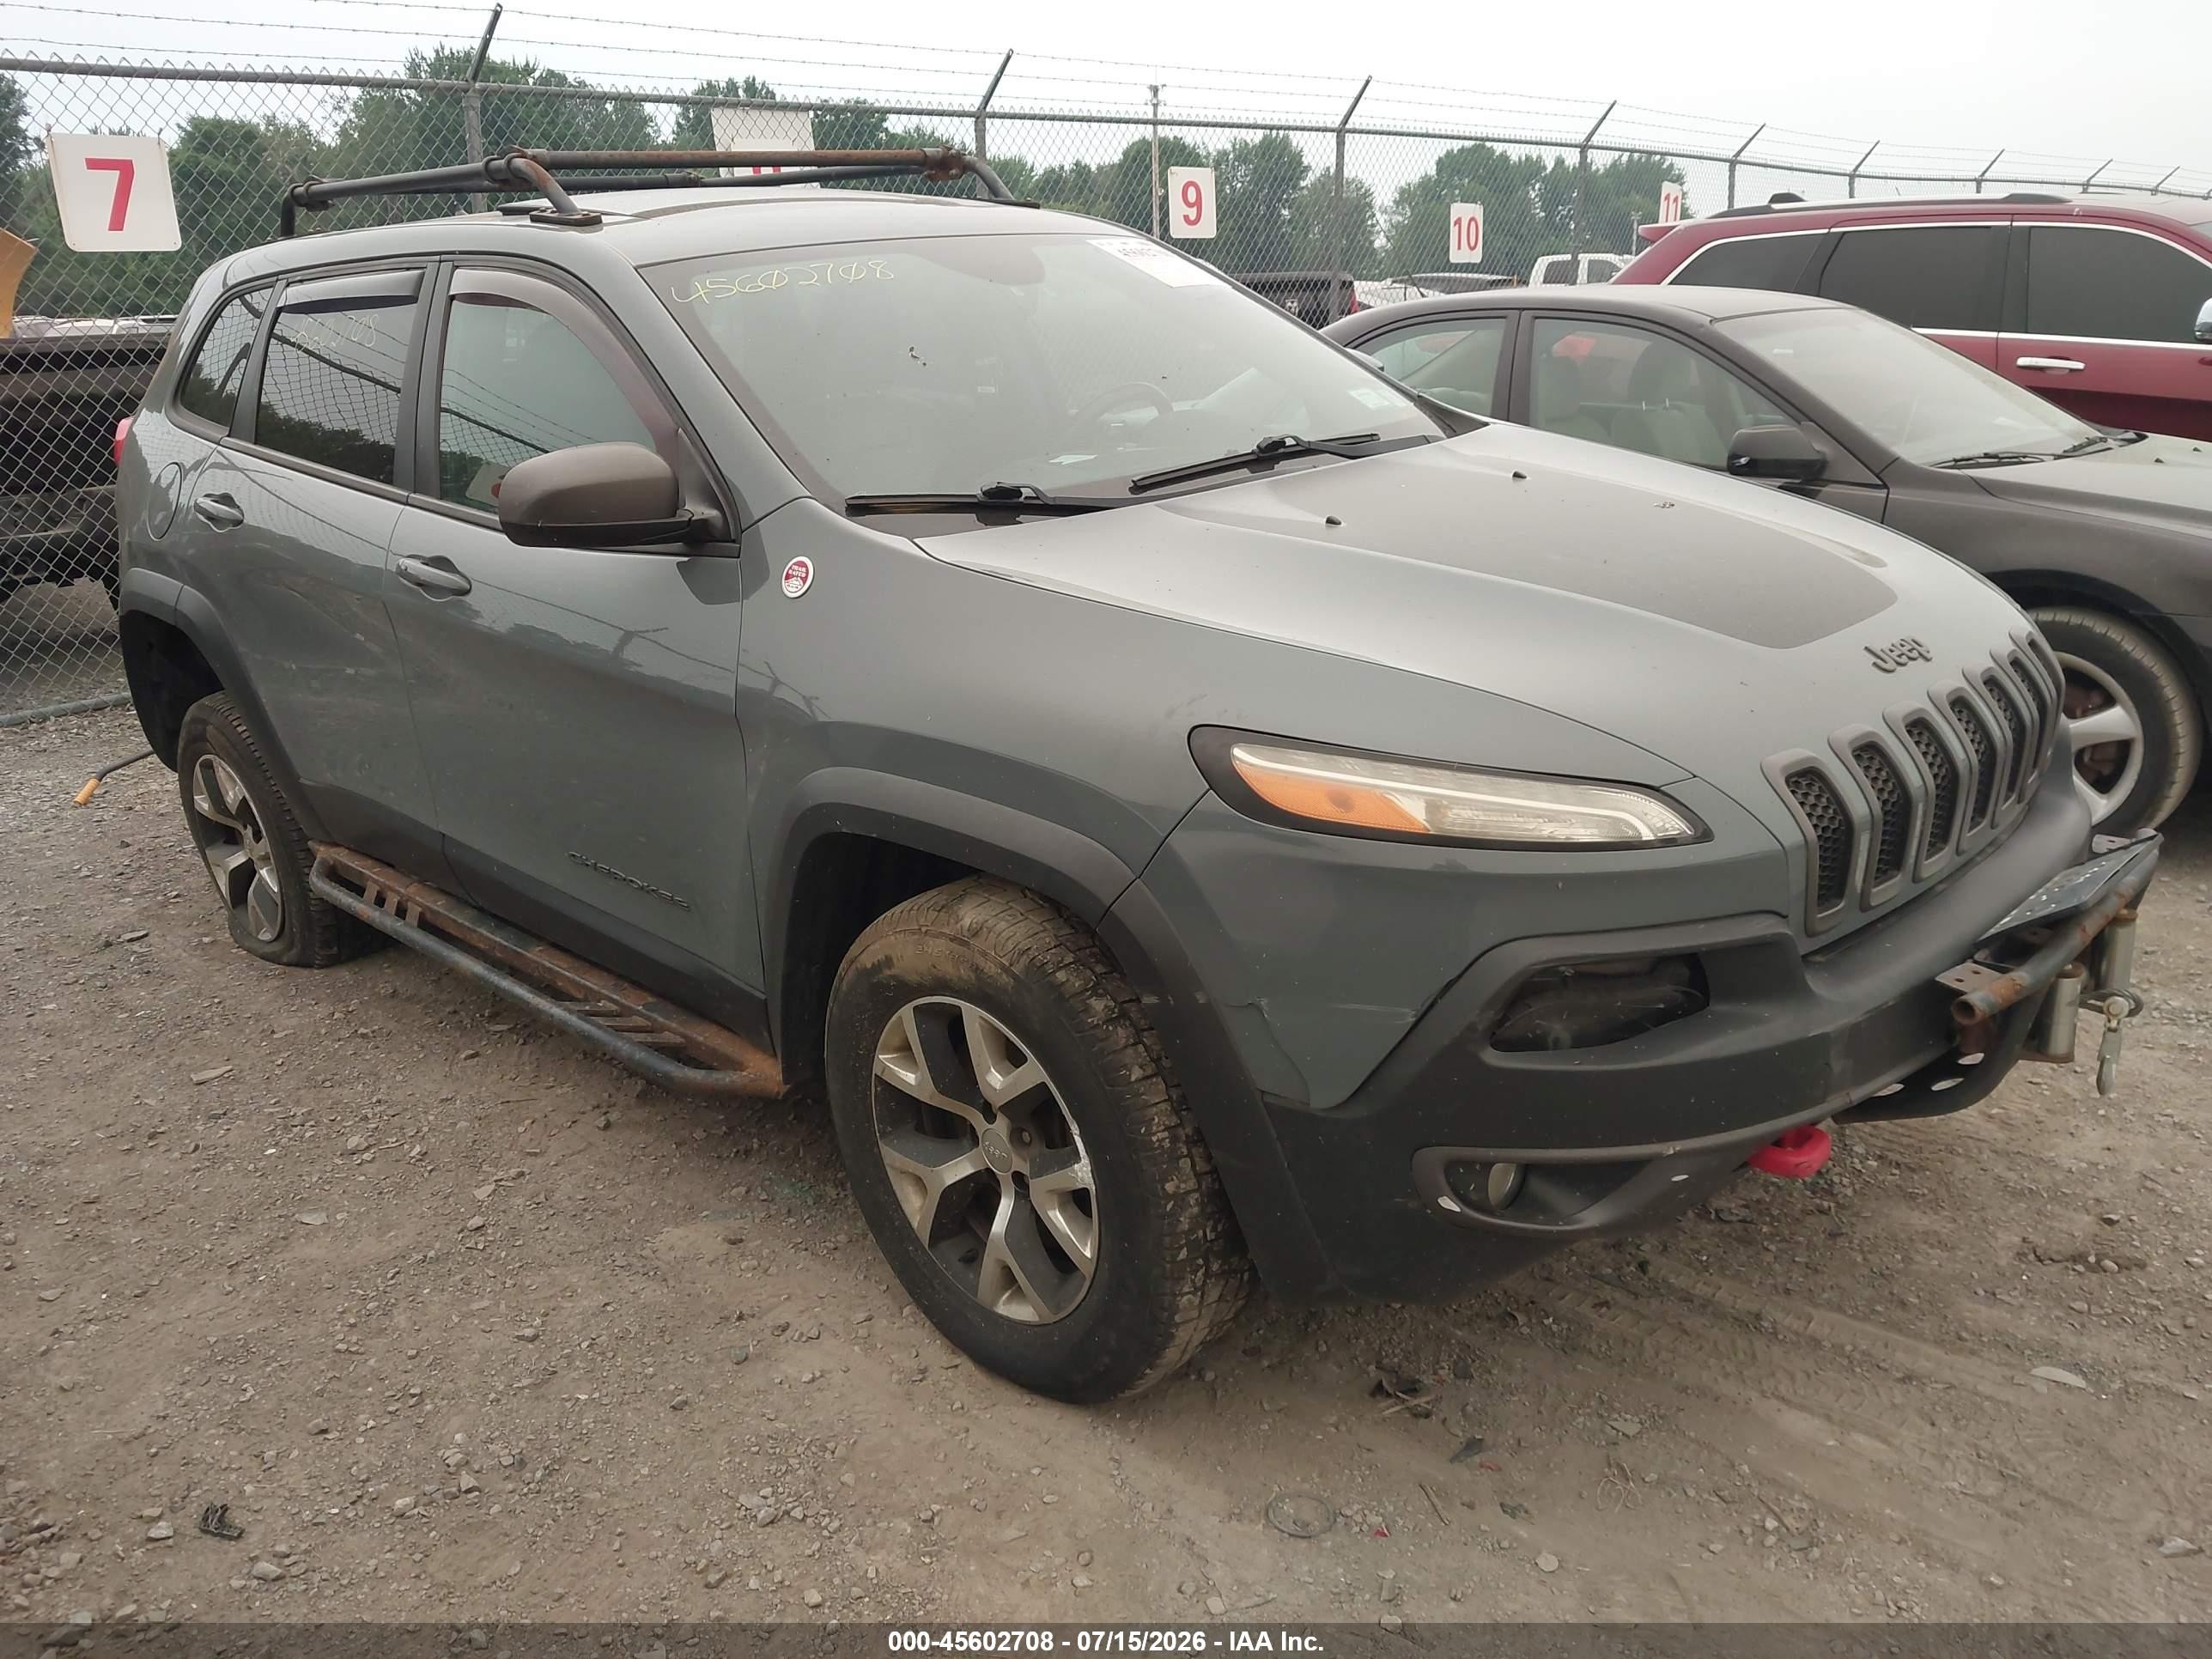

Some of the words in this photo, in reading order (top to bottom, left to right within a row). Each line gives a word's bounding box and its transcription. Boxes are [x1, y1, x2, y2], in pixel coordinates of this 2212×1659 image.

[84, 157, 136, 232] 7
[1181, 179, 1203, 227] 9
[1663, 191, 1679, 222] 11
[1453, 216, 1480, 252] 10
[1863, 638, 1933, 674] Jeep
